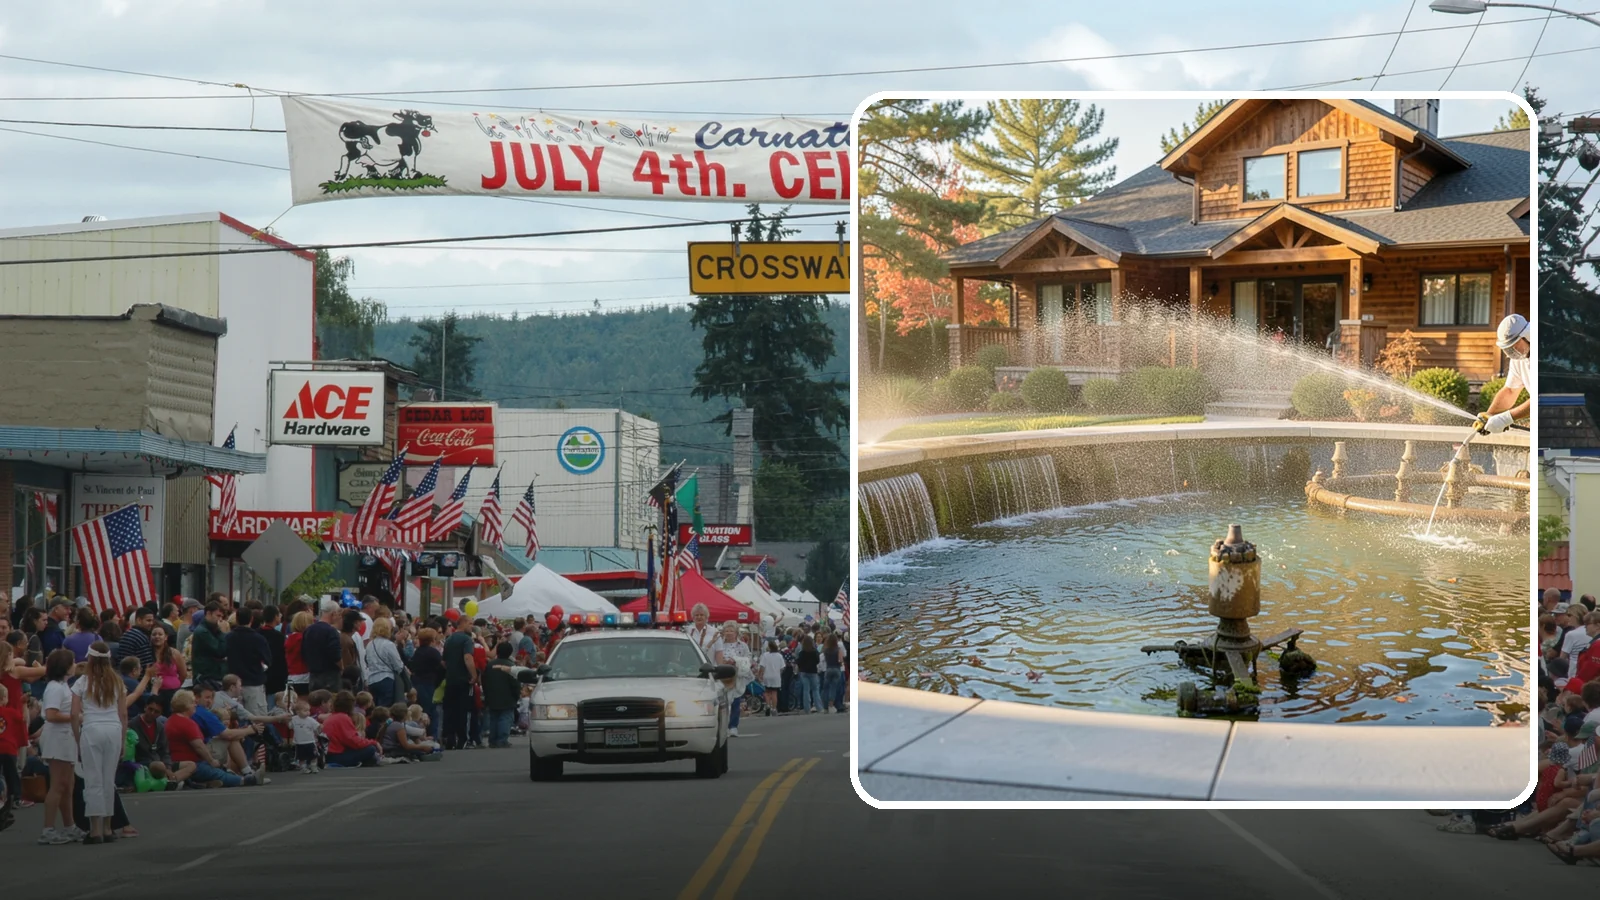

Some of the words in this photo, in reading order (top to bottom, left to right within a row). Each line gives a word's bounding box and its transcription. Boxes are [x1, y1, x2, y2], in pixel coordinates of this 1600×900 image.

[481, 141, 605, 192] JULY
[632, 150, 746, 198] 4th.
[697, 254, 850, 280] CROSSWA
[283, 380, 373, 420] ACE
[405, 409, 452, 422] CEDAR
[283, 421, 370, 436] Hardware
[416, 428, 476, 447] Coca-Cola
[353, 467, 386, 481] Simpl
[83, 485, 93, 494] St.
[95, 485, 124, 495] Vincent
[126, 486, 136, 495] de
[138, 486, 155, 495] Paul
[688, 526, 741, 535] CRNATION
[699, 535, 730, 543] GLASS
